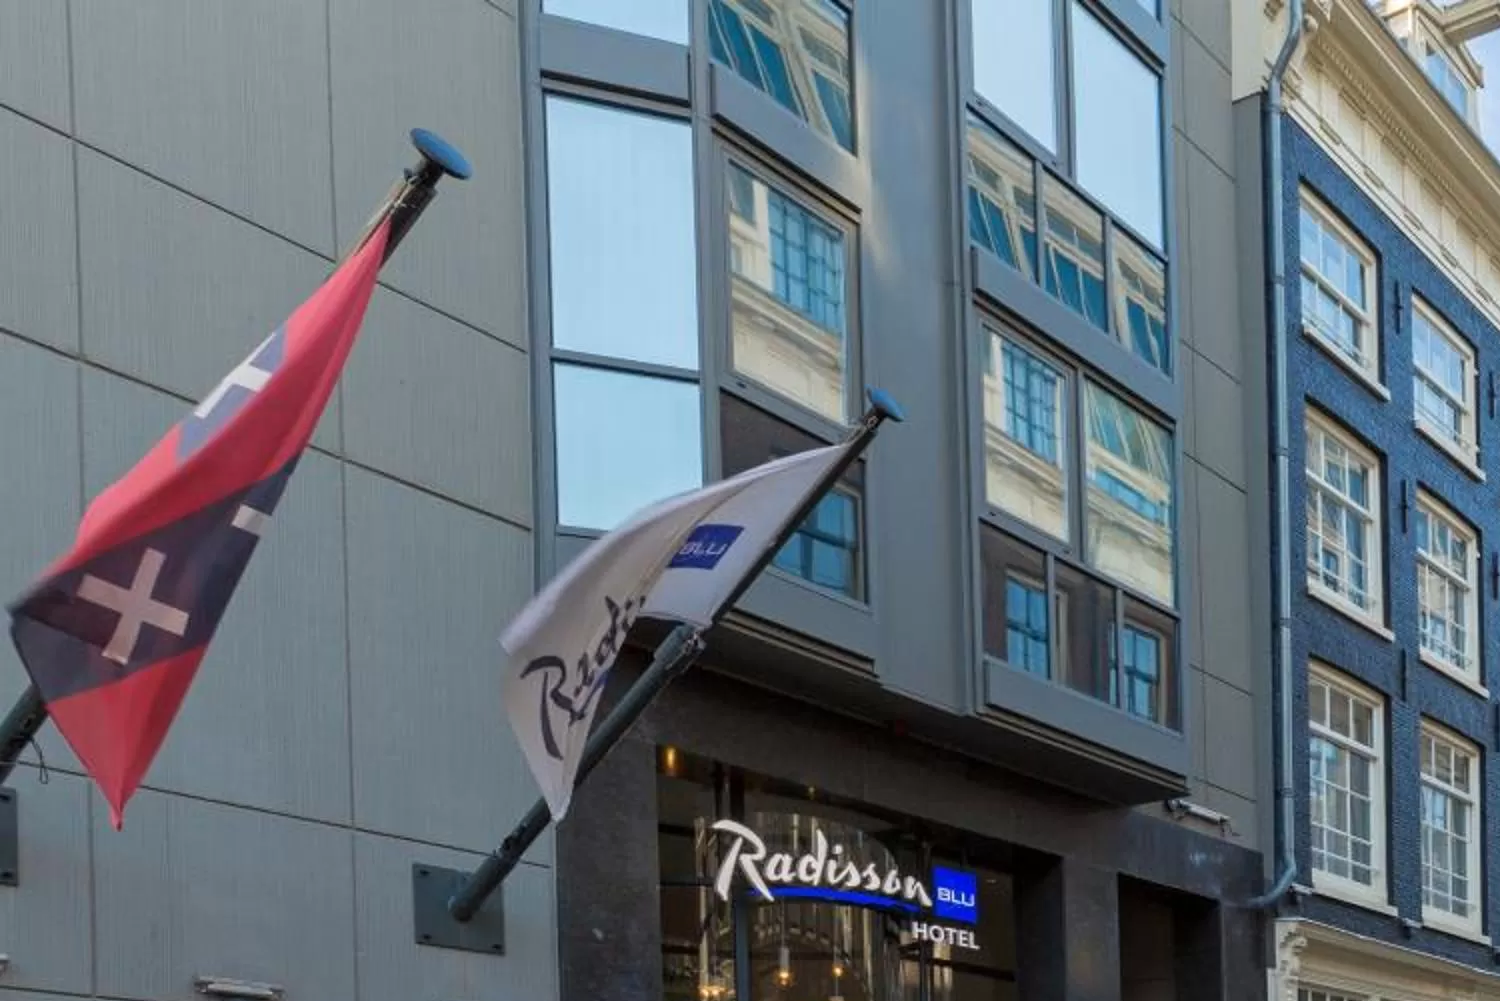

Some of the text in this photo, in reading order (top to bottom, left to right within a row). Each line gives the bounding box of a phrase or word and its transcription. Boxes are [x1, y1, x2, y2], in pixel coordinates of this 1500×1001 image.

[712, 820, 976, 908] Radisson BLU
[912, 922, 980, 950] HOTEL
